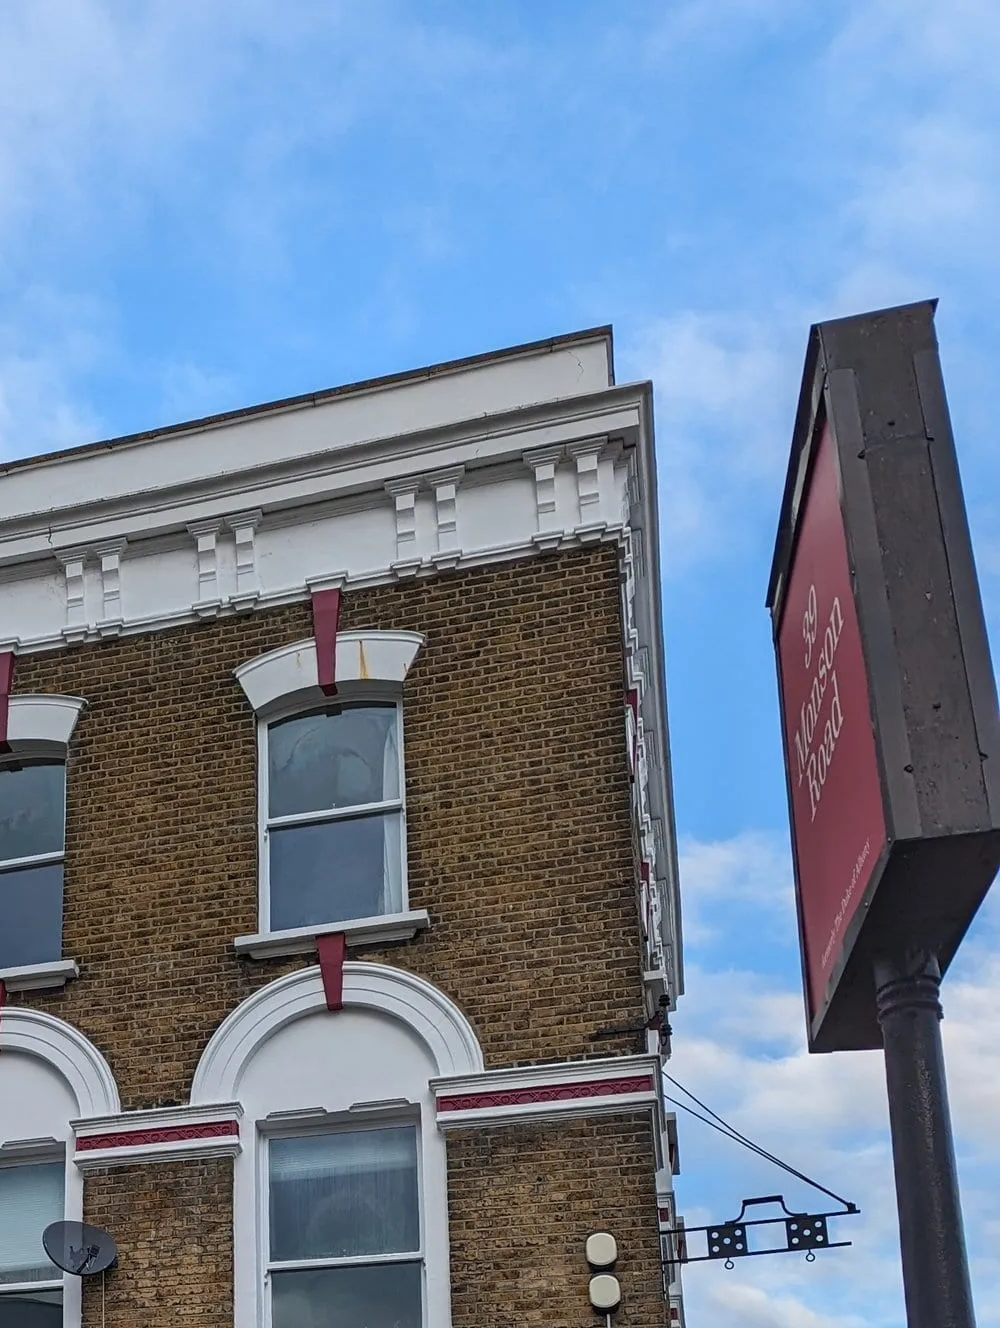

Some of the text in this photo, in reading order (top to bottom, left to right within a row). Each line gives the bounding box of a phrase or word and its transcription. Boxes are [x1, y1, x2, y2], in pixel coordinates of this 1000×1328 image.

[794, 596, 844, 788] Monson
[802, 584, 817, 669] 39
[806, 670, 843, 822] Road
